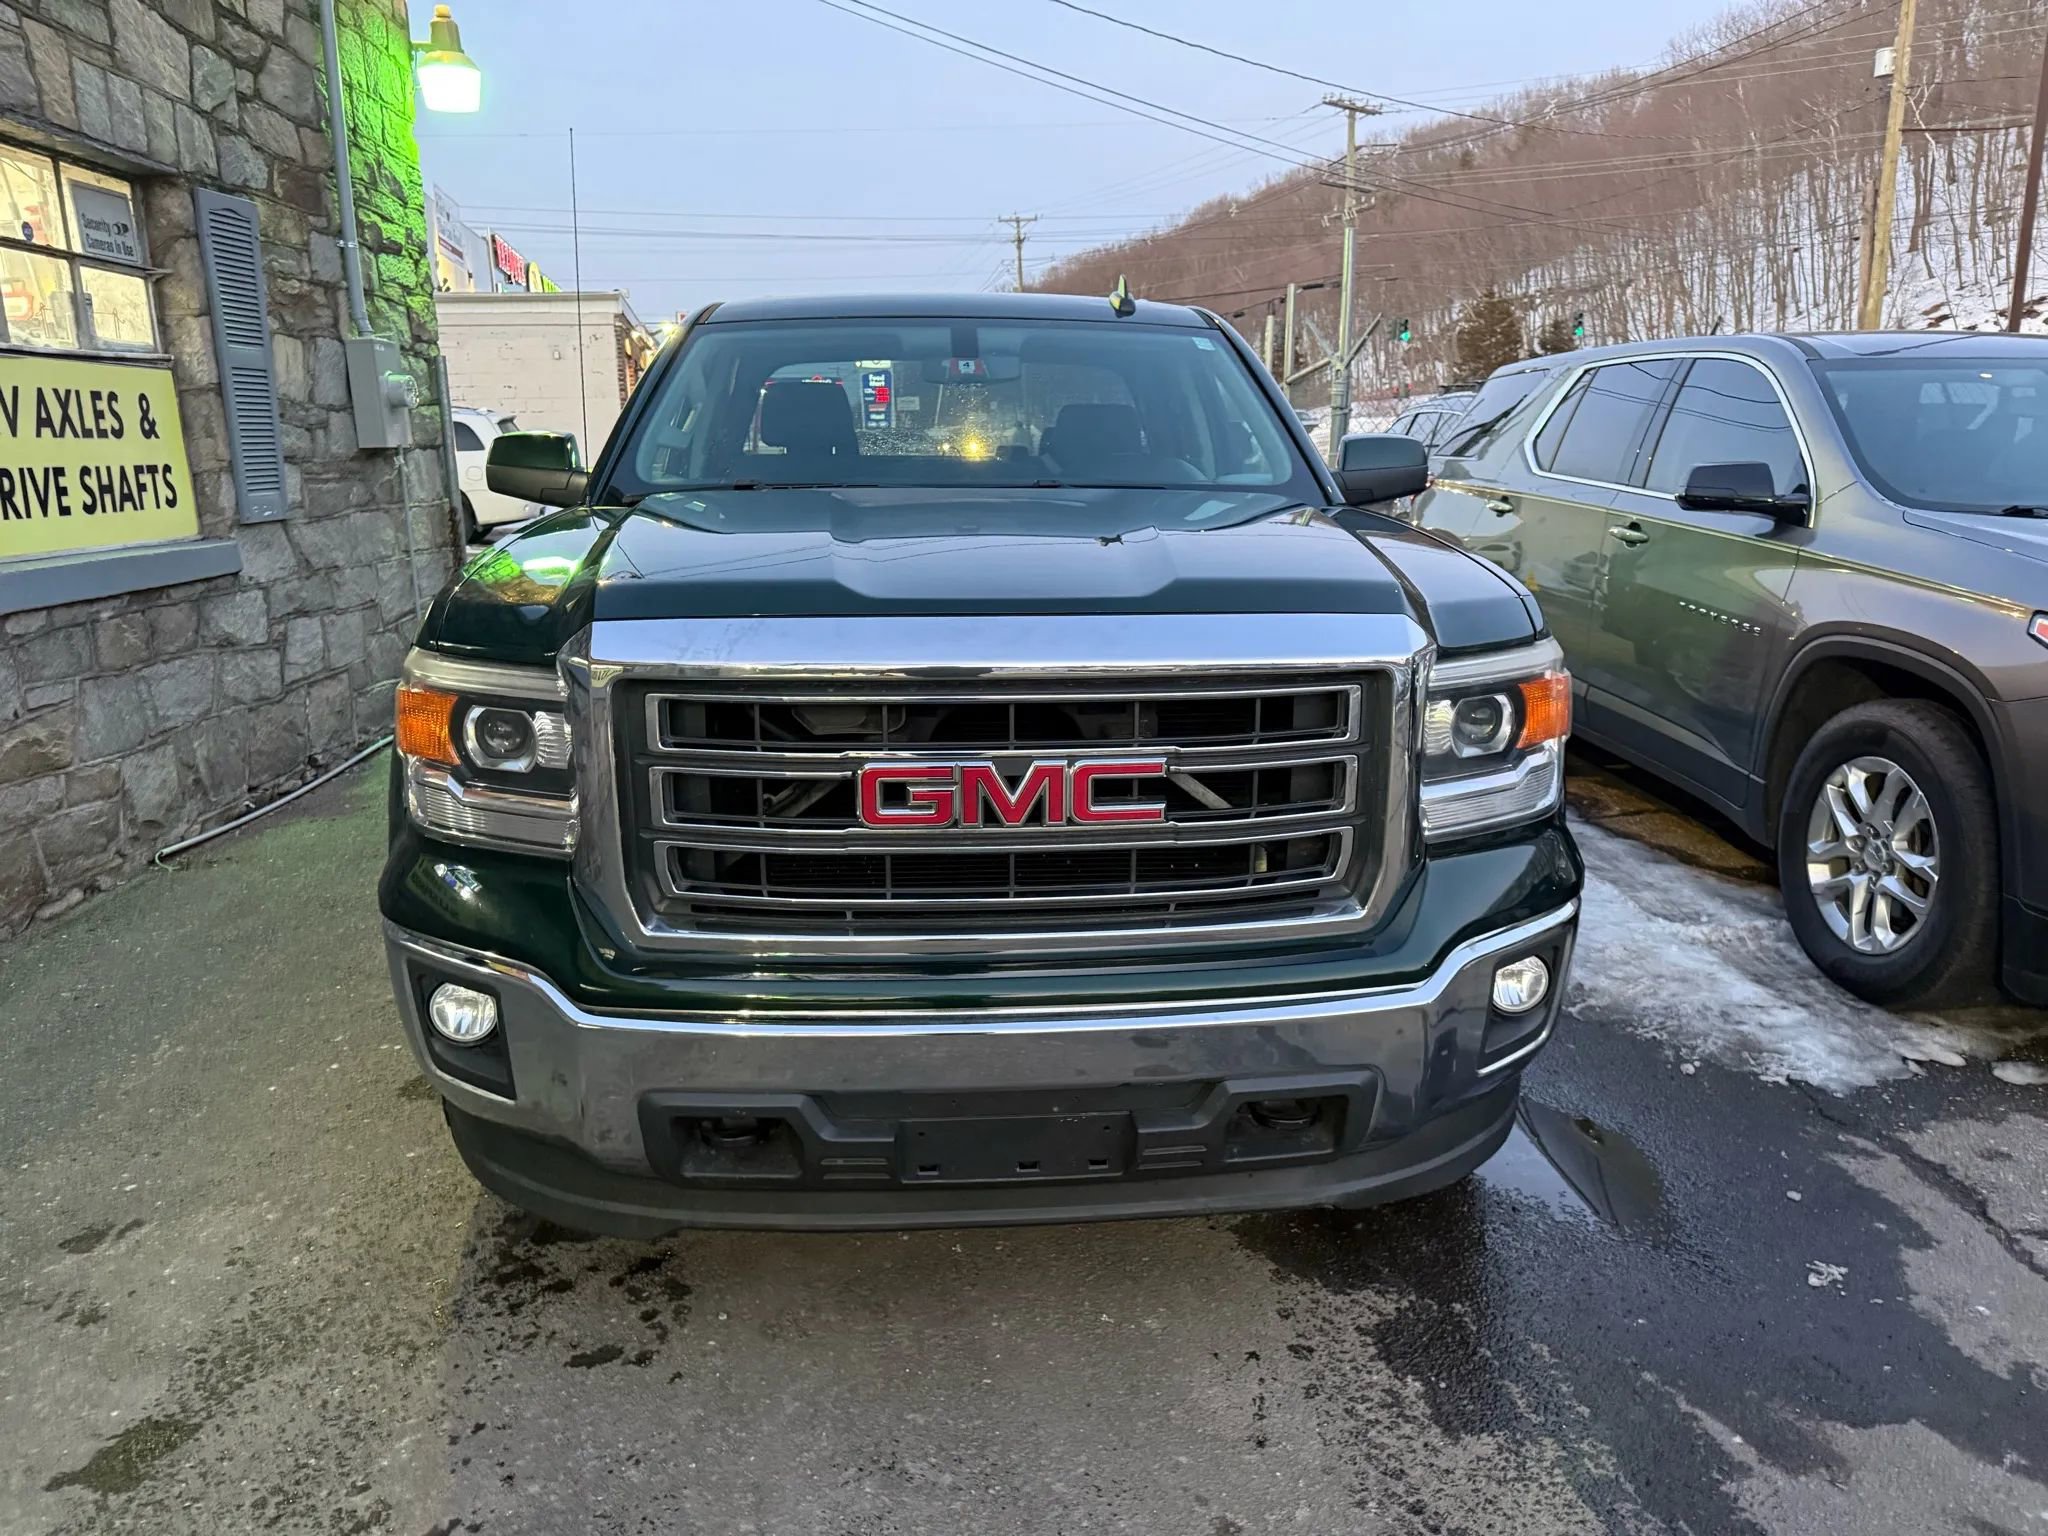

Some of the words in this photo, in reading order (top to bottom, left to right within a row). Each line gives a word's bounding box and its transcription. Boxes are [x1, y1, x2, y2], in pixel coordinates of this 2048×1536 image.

[81, 212, 113, 237] Security
[85, 233, 115, 253] Cameras
[121, 240, 135, 257] Use
[35, 386, 125, 440] AXLES
[138, 392, 161, 440] &
[0, 466, 72, 520] RIVE
[79, 463, 178, 516] SHAFTS
[857, 757, 1168, 829] GMC
